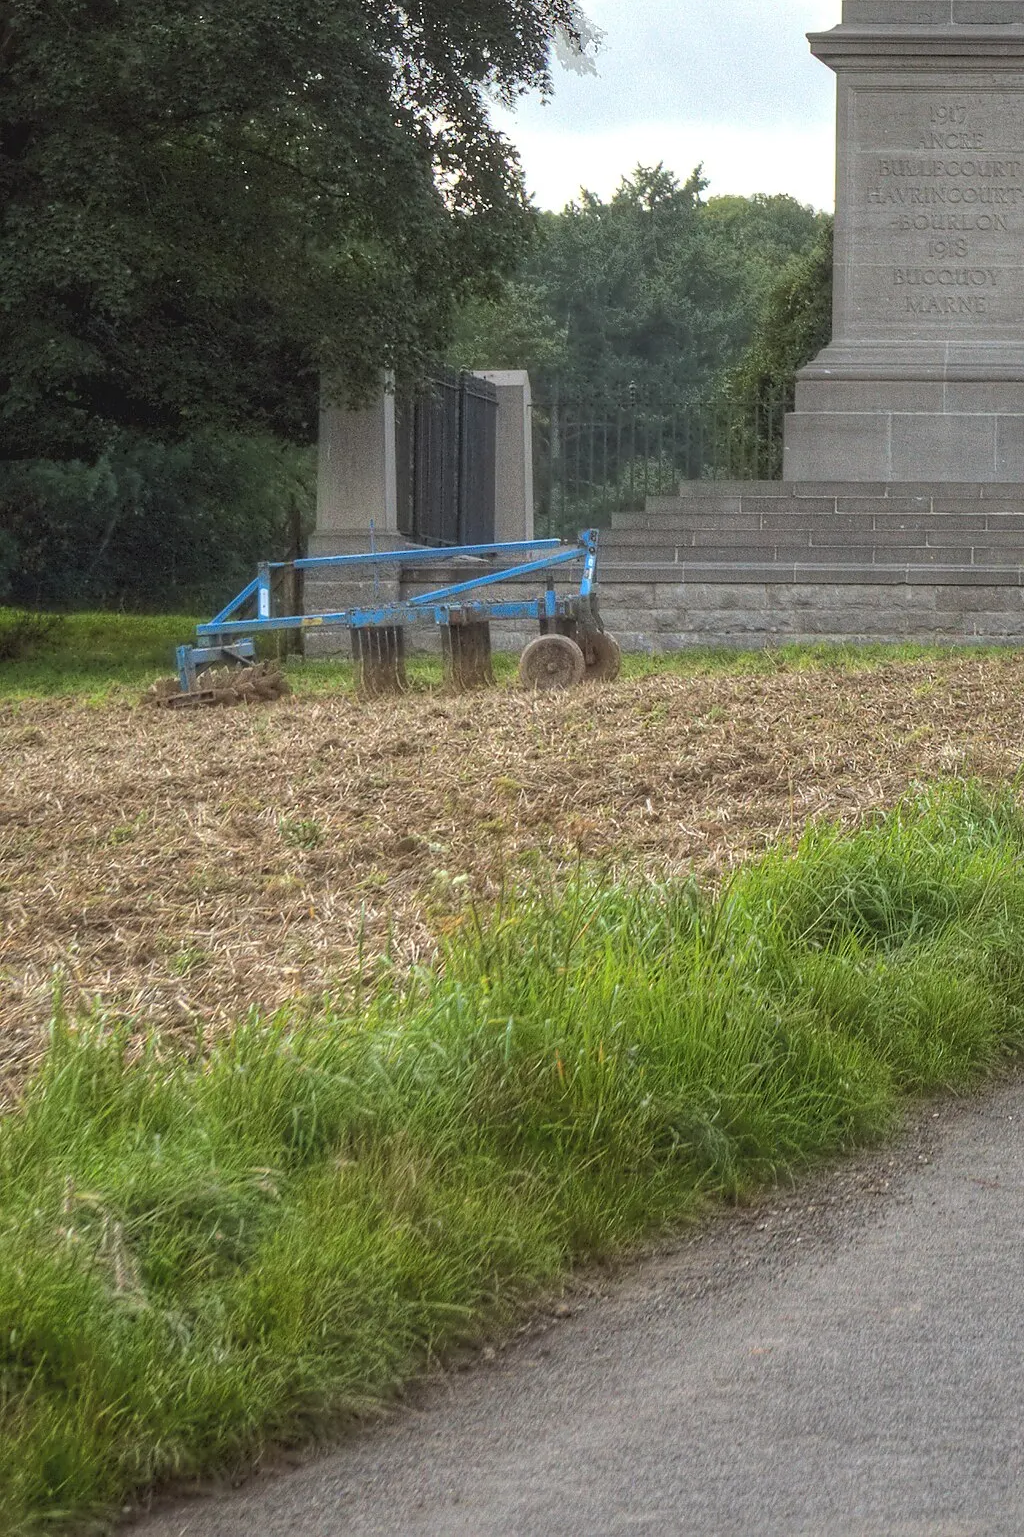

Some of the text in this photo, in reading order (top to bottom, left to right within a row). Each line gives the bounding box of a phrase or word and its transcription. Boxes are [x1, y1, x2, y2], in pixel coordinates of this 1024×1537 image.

[930, 105, 967, 125] 1917
[915, 132, 984, 149] ANCRE
[879, 160, 1021, 177] BULLECOURT
[929, 238, 968, 259] 1918
[893, 268, 999, 285] BUCQUOY
[904, 296, 986, 313] MARNE
